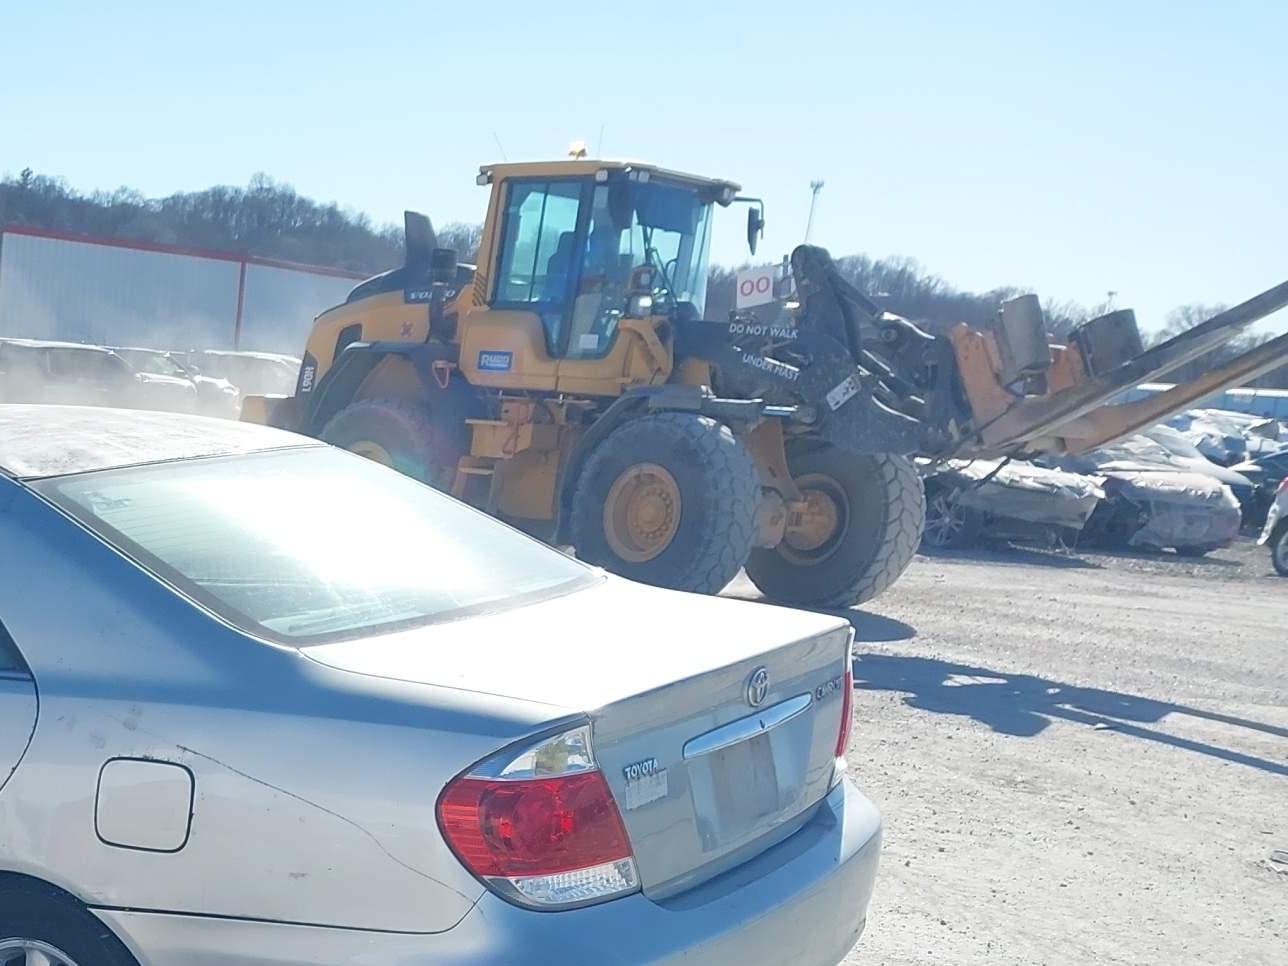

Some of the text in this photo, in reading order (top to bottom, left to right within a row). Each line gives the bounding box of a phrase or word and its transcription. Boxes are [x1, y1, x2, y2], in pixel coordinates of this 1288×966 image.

[729, 323, 799, 339] DO NOT WALK
[742, 353, 800, 381] UNDER MAST
[623, 758, 658, 780] TOYOTA
